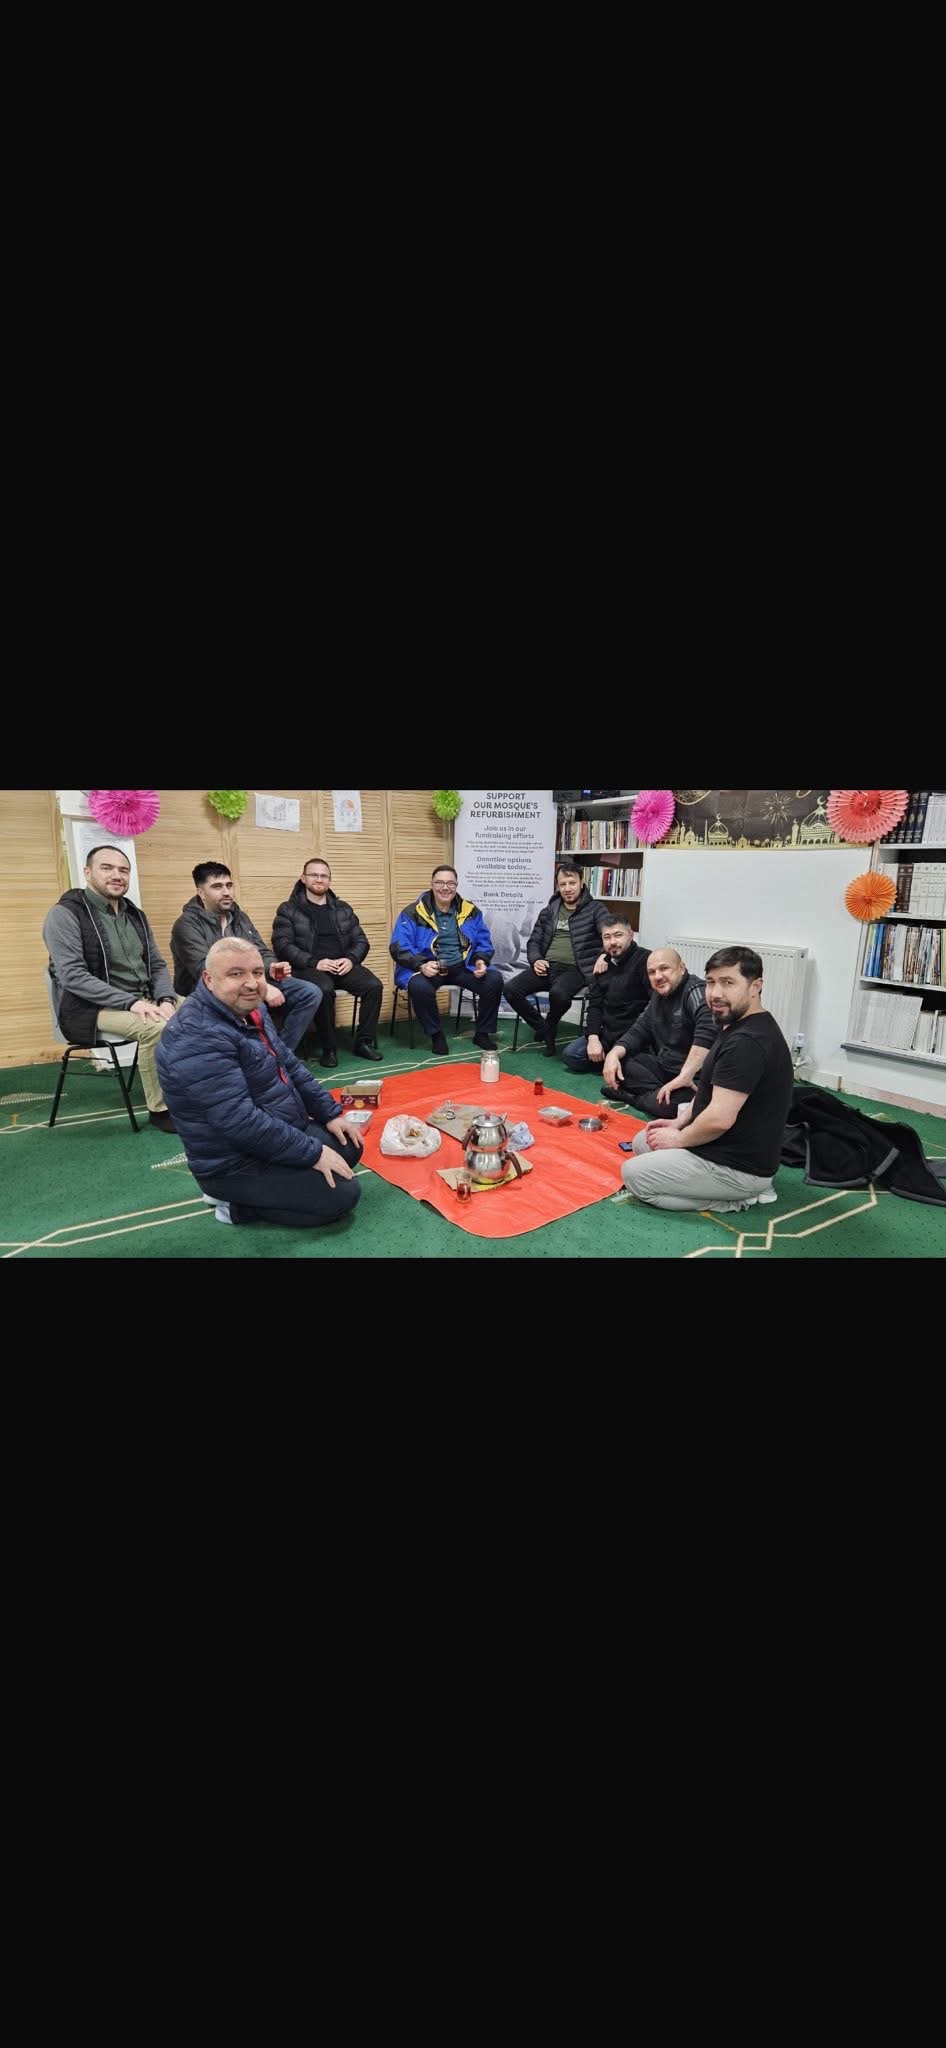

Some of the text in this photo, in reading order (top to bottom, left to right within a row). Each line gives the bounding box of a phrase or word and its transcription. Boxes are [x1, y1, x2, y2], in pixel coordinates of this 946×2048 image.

[486, 792, 526, 800] SUPPORT
[473, 801, 539, 811] OUR MOSQUE'S
[470, 810, 542, 819] REFURBISHMENT
[475, 832, 535, 840] fundraising efforts
